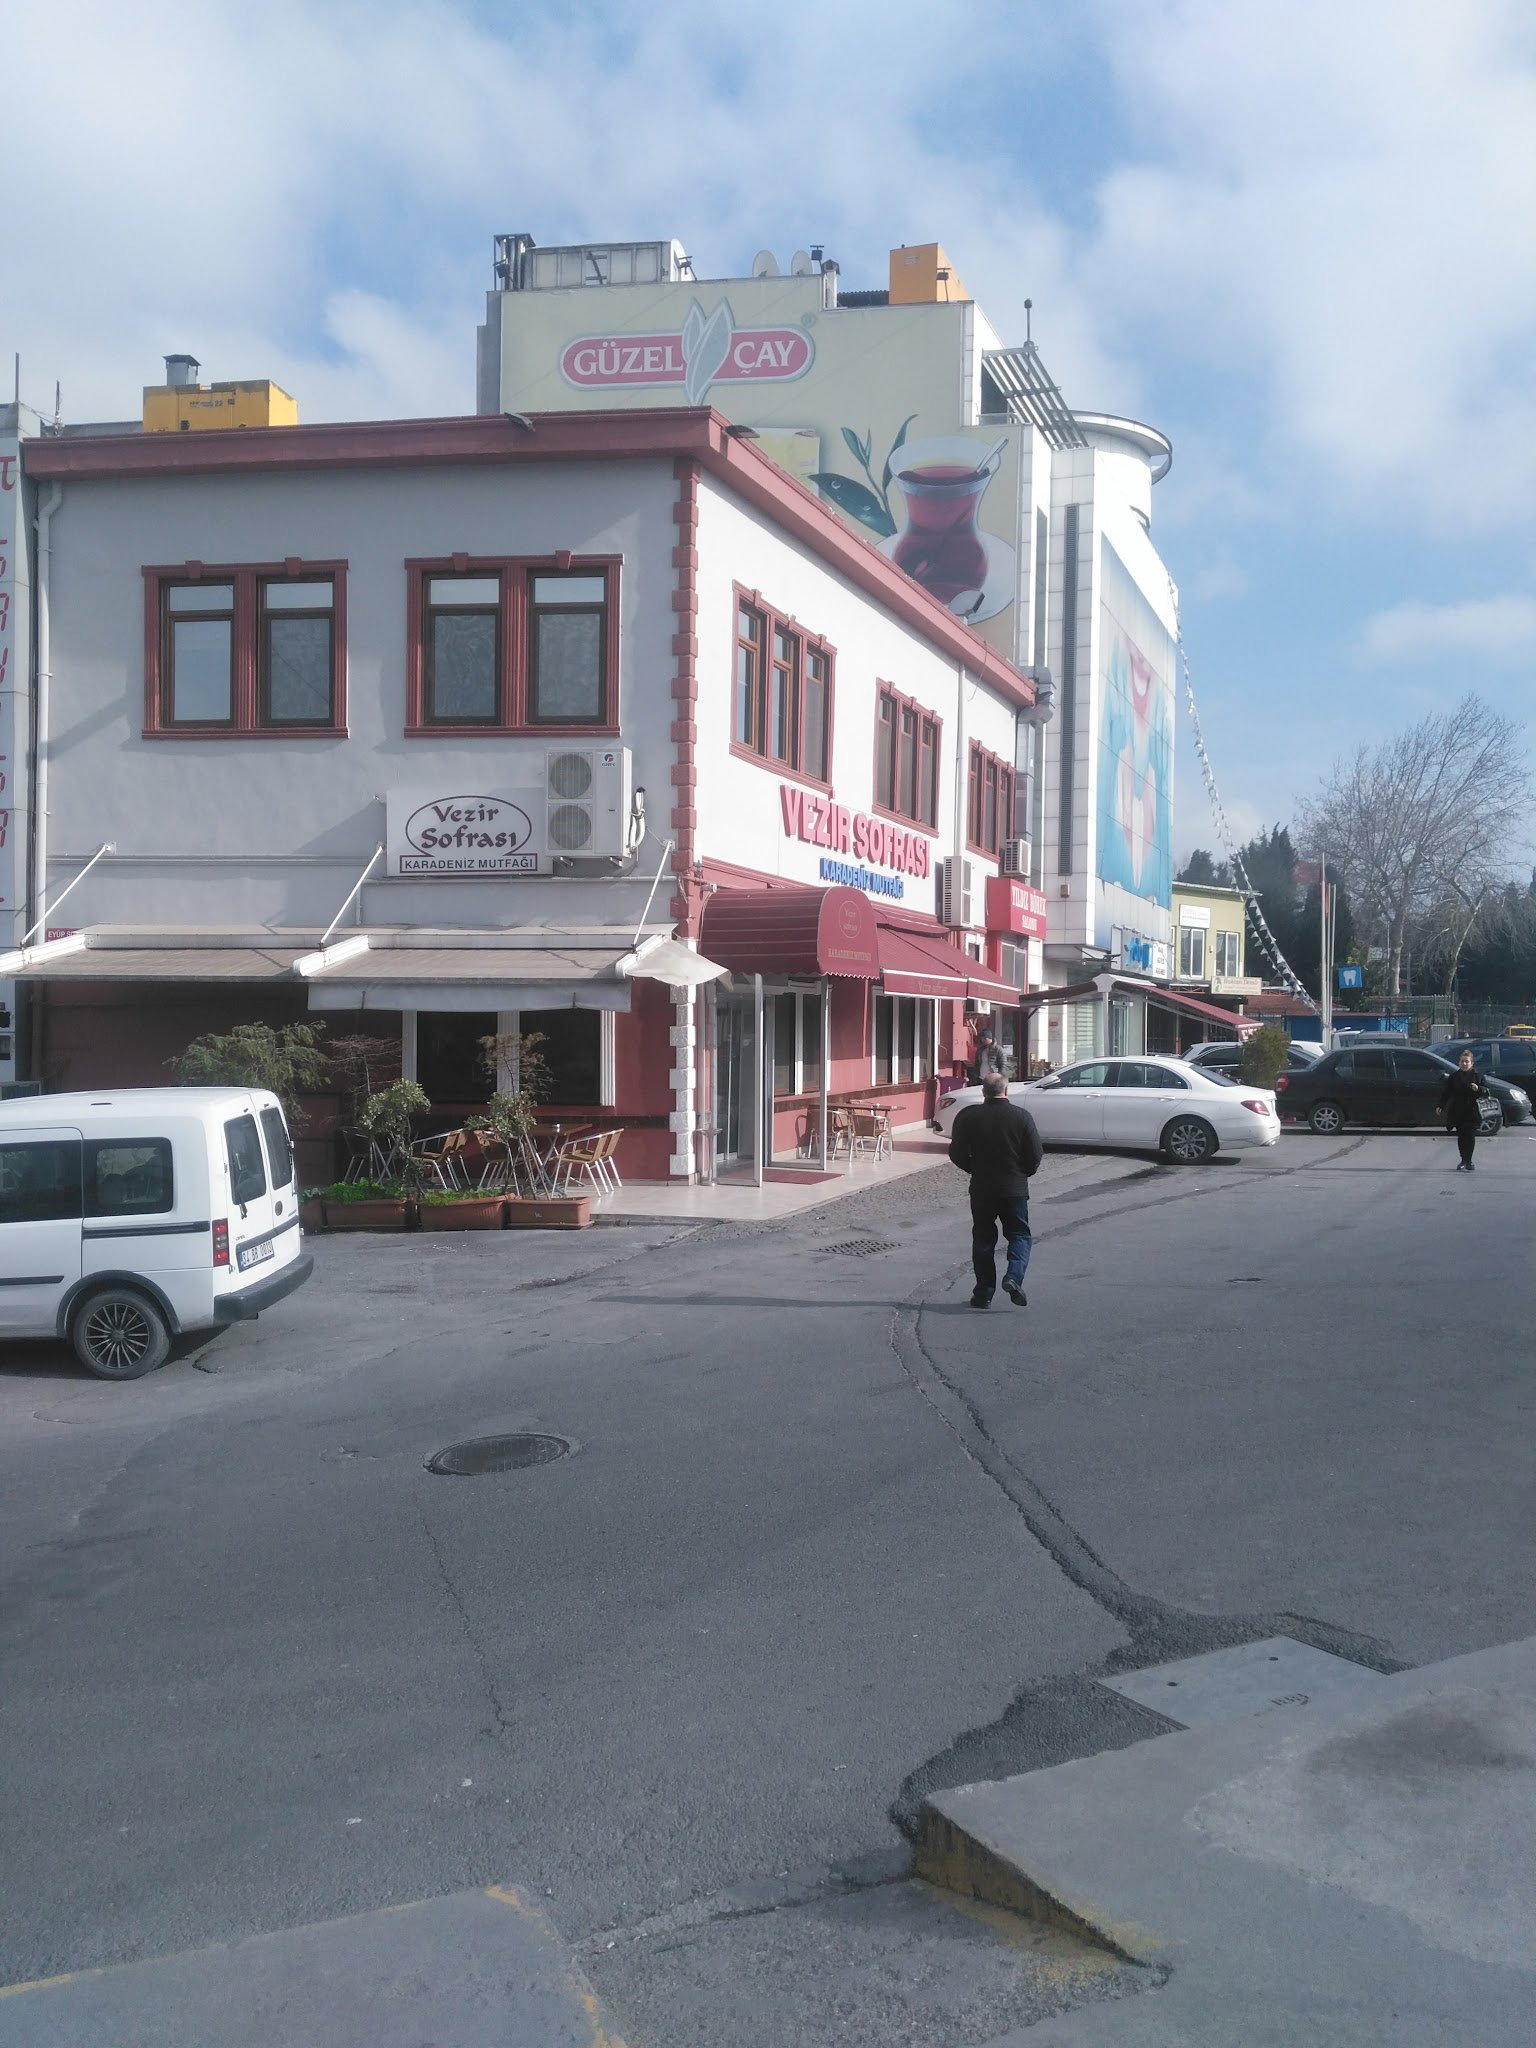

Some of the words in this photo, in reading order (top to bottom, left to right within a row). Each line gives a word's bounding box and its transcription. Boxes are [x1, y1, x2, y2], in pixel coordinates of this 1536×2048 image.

[573, 341, 684, 376] GÜZEL
[733, 340, 796, 374] ÇAY
[432, 804, 499, 822] Vezir
[421, 825, 517, 848] Sofrası
[853, 813, 930, 879] SOFRASI
[405, 857, 475, 869] KARADENİZ
[478, 856, 533, 868] MUTFAĞI
